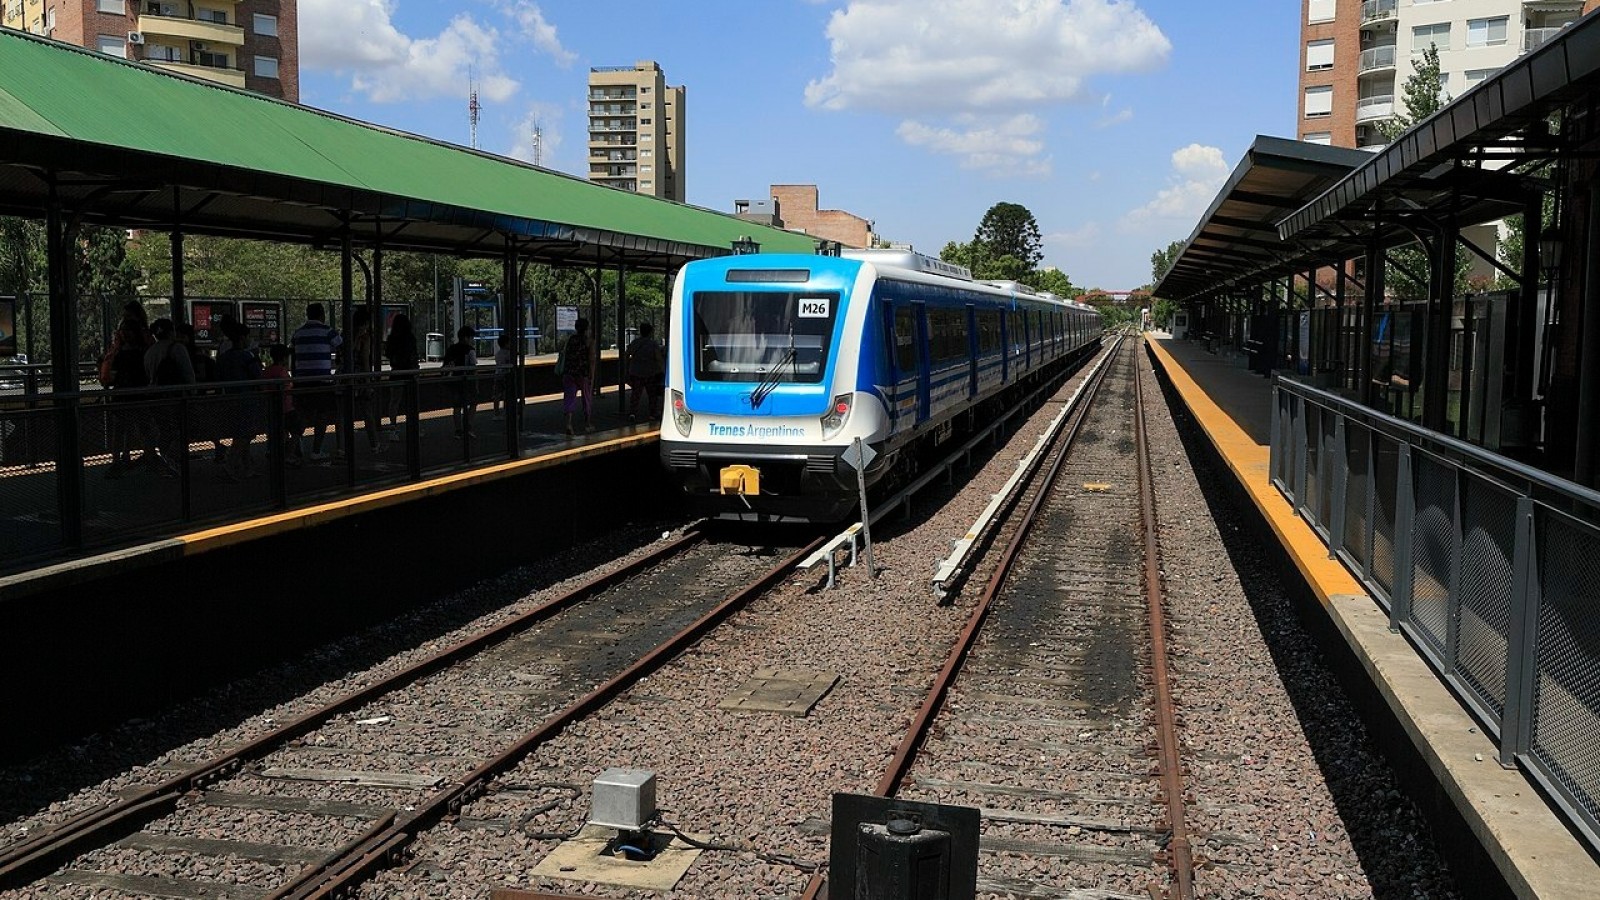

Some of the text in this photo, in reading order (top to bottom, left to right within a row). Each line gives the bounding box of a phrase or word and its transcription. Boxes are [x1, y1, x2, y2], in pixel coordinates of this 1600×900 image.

[802, 303, 826, 315] M26
[708, 422, 805, 439] Trenes Argentinos
